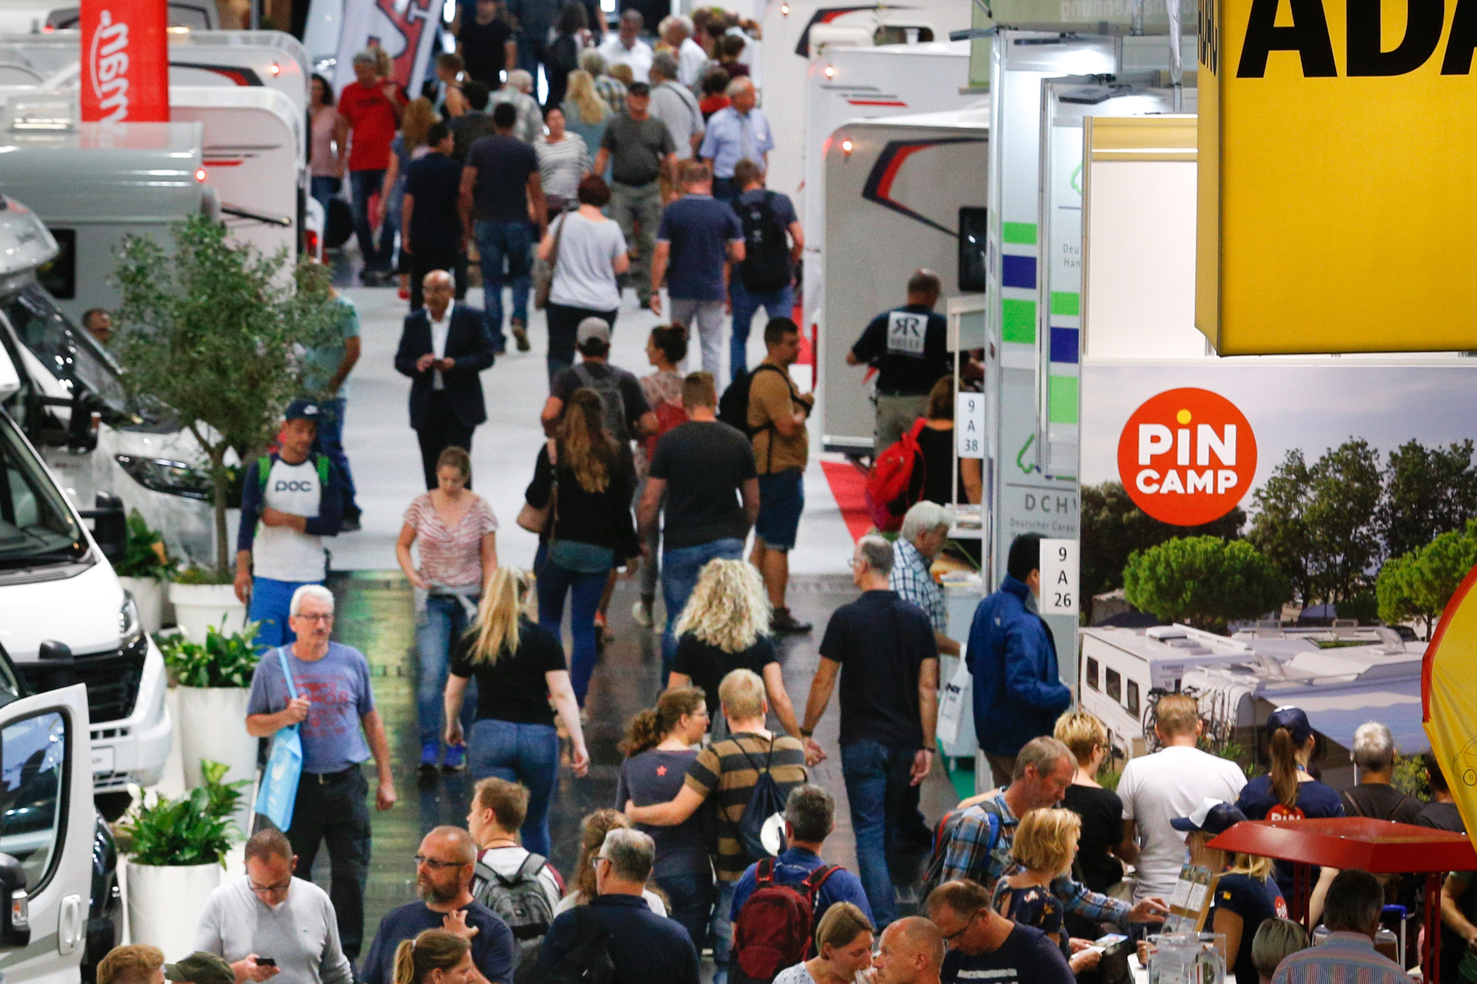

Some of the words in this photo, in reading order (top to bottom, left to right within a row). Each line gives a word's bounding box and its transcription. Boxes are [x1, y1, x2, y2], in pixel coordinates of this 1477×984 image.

[967, 400, 975, 413] 9
[967, 420, 976, 432] A
[964, 439, 979, 452] 38
[1136, 468, 1238, 494] CAMP
[1058, 546, 1067, 562] 9
[1057, 570, 1068, 585] A
[1054, 592, 1072, 608] 26
